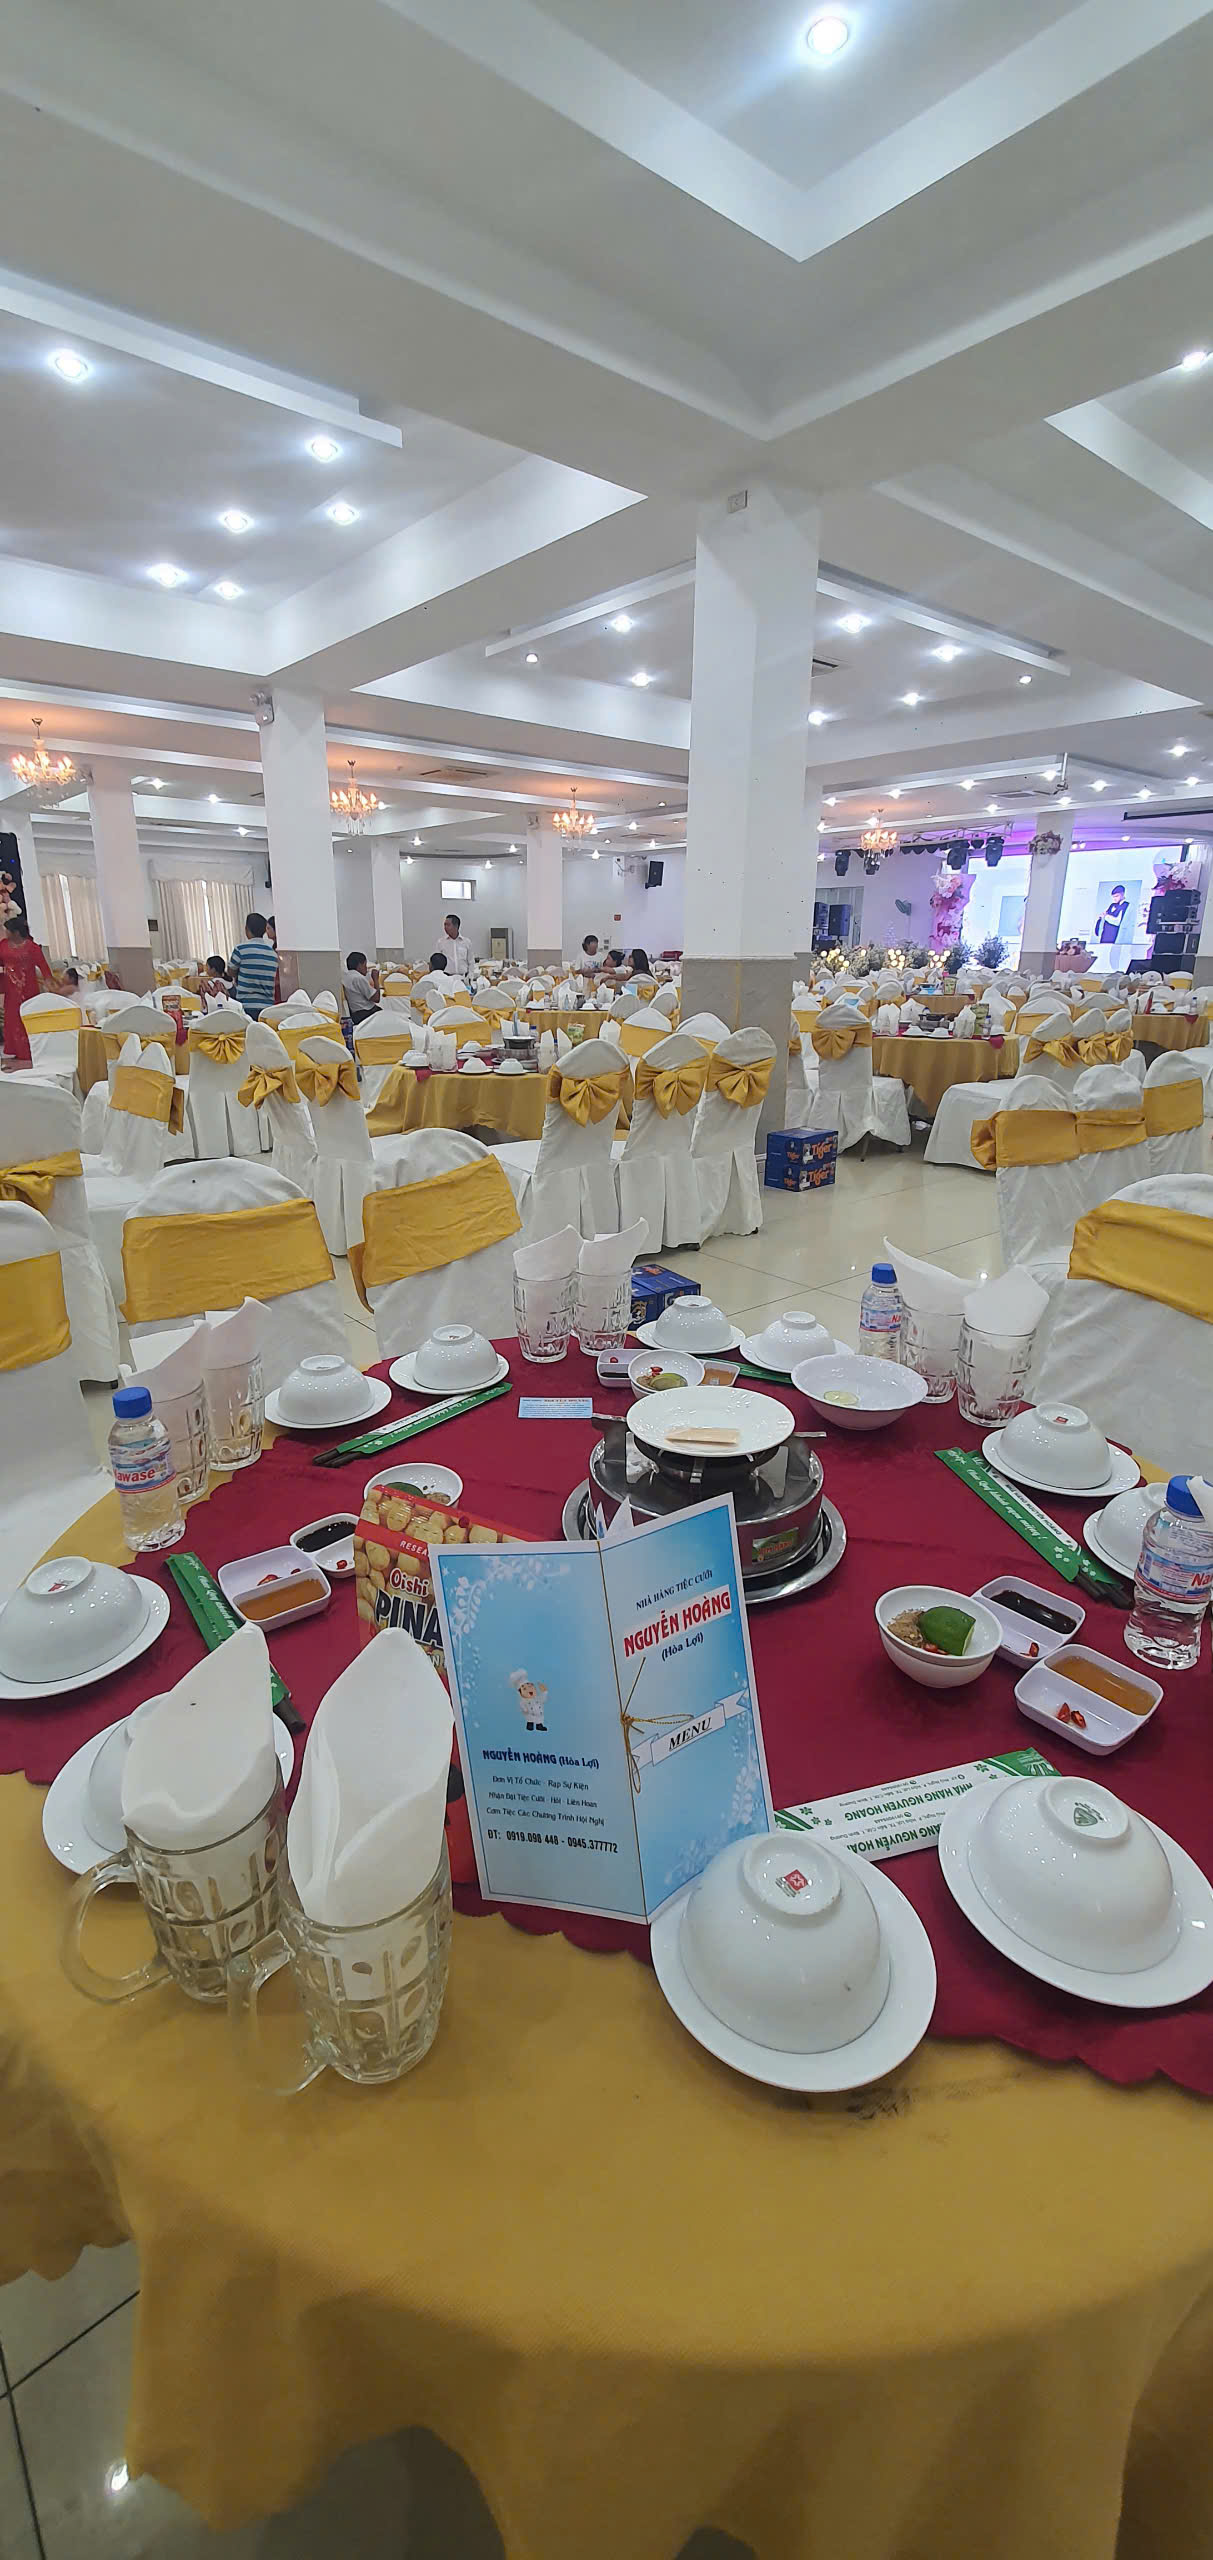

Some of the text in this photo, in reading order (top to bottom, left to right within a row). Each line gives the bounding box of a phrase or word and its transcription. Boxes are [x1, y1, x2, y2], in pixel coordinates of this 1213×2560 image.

[812, 1142, 833, 1159] Tiger
[808, 1168, 830, 1186] Tiger
[400, 1540, 429, 1557] RESEA
[389, 1567, 430, 1597] Oishi
[635, 1569, 713, 1610] NHÀ HÀNG TIỆC CƯỚI
[623, 1592, 731, 1657] NGUYỄN HOÀNG
[661, 1632, 704, 1661] (Hòa Lợi)
[669, 1717, 711, 1751] MENU
[482, 1747, 600, 1770] NGUYỄN HOÀNG (Hòa Lợi)
[573, 1781, 589, 1791] Kiện
[581, 1799, 598, 1808] Hoan
[558, 1812, 575, 1822] Trình
[488, 1829, 501, 1840] ĐT:
[506, 1831, 543, 1844] 0919.098
[544, 1834, 559, 1845] 448
[567, 1837, 619, 1854] 0945.377772
